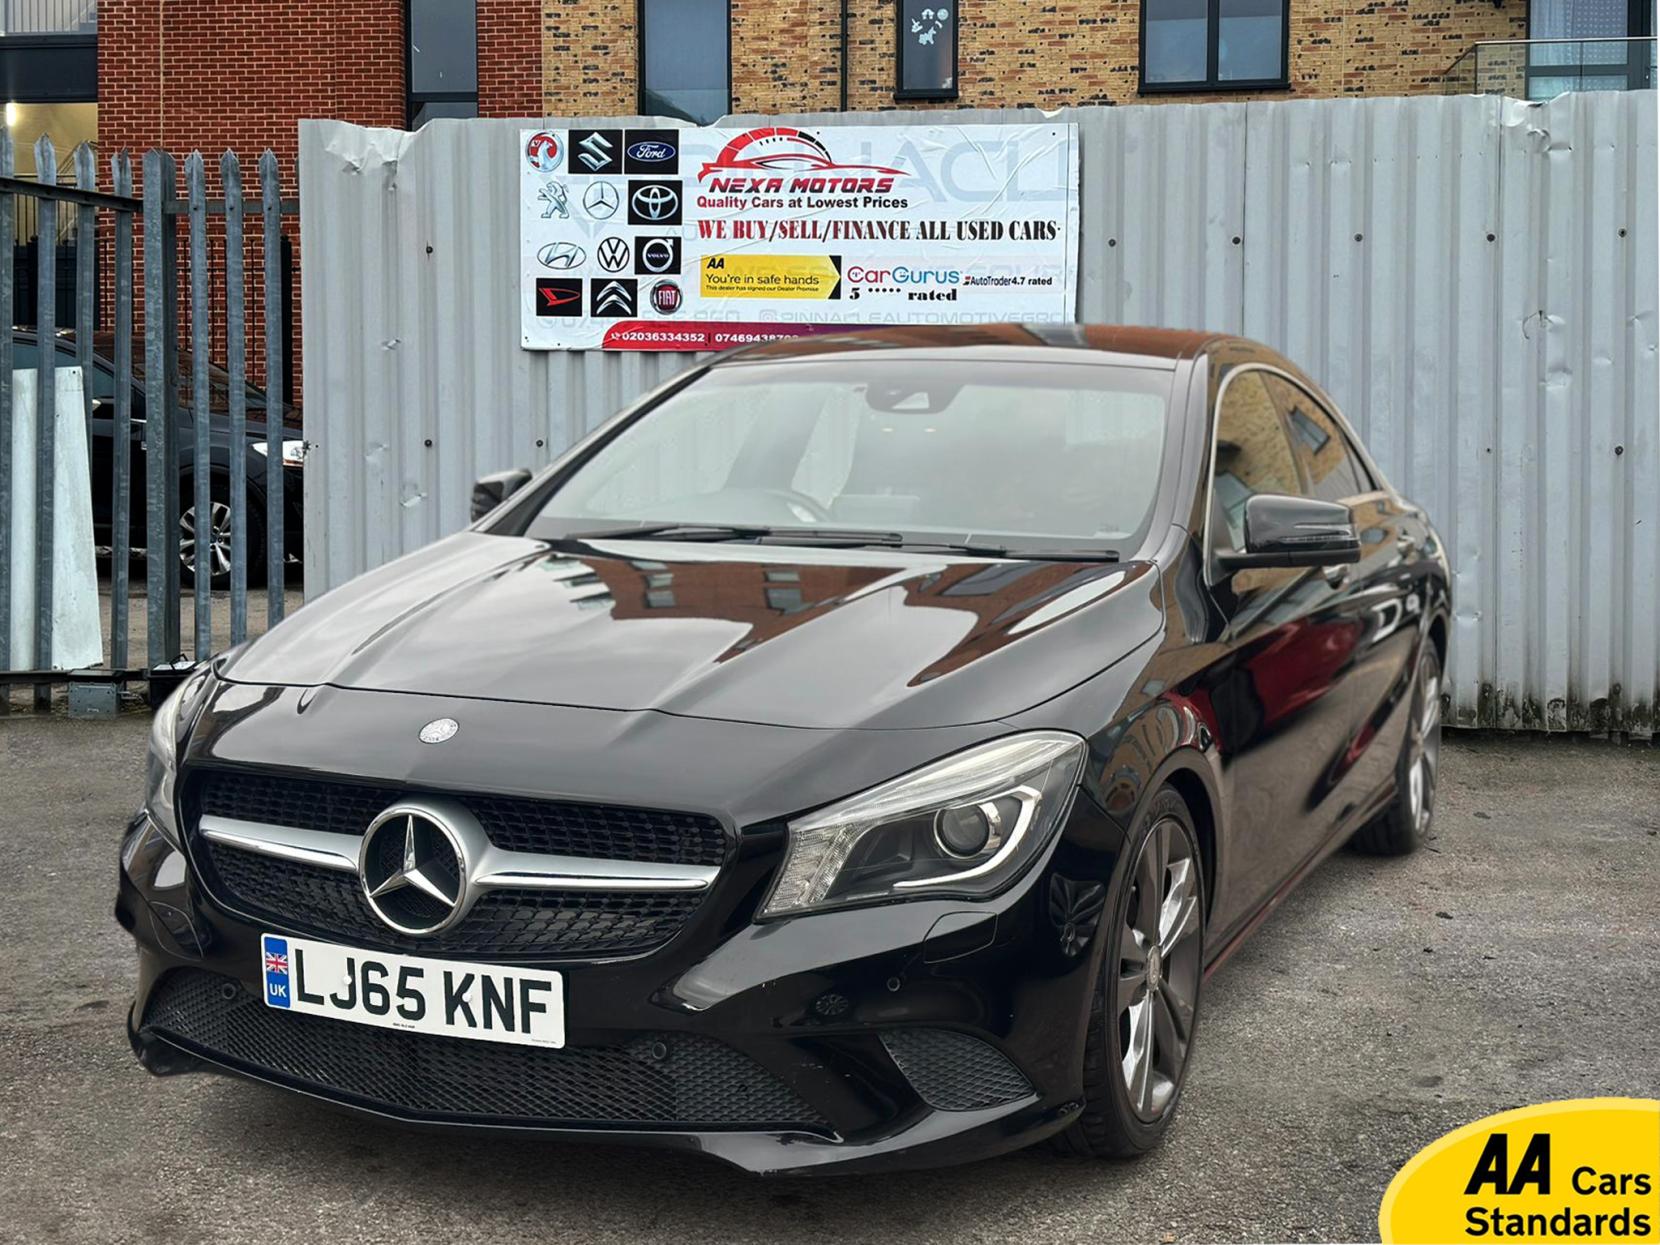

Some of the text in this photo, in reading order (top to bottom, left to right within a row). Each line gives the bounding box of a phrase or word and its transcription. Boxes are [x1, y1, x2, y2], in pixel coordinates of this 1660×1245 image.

[635, 144, 667, 159] Ford
[709, 178, 895, 194] NEXA MOTORS
[697, 196, 909, 210] Quality Cars at Lowest Prices
[697, 220, 728, 240] WE
[916, 221, 951, 240] ALL
[956, 221, 1004, 241] USED
[1008, 220, 1057, 241] CARS
[706, 257, 725, 269] AA
[706, 274, 820, 285] You're in safe hands
[847, 266, 960, 284] CarGurus
[1028, 277, 1053, 286] rated
[658, 290, 677, 305] FIAT
[849, 287, 957, 301] 5 rated
[622, 332, 705, 342] 02036334352
[269, 984, 287, 998] UK
[295, 949, 552, 1034] LJ65 KNF
